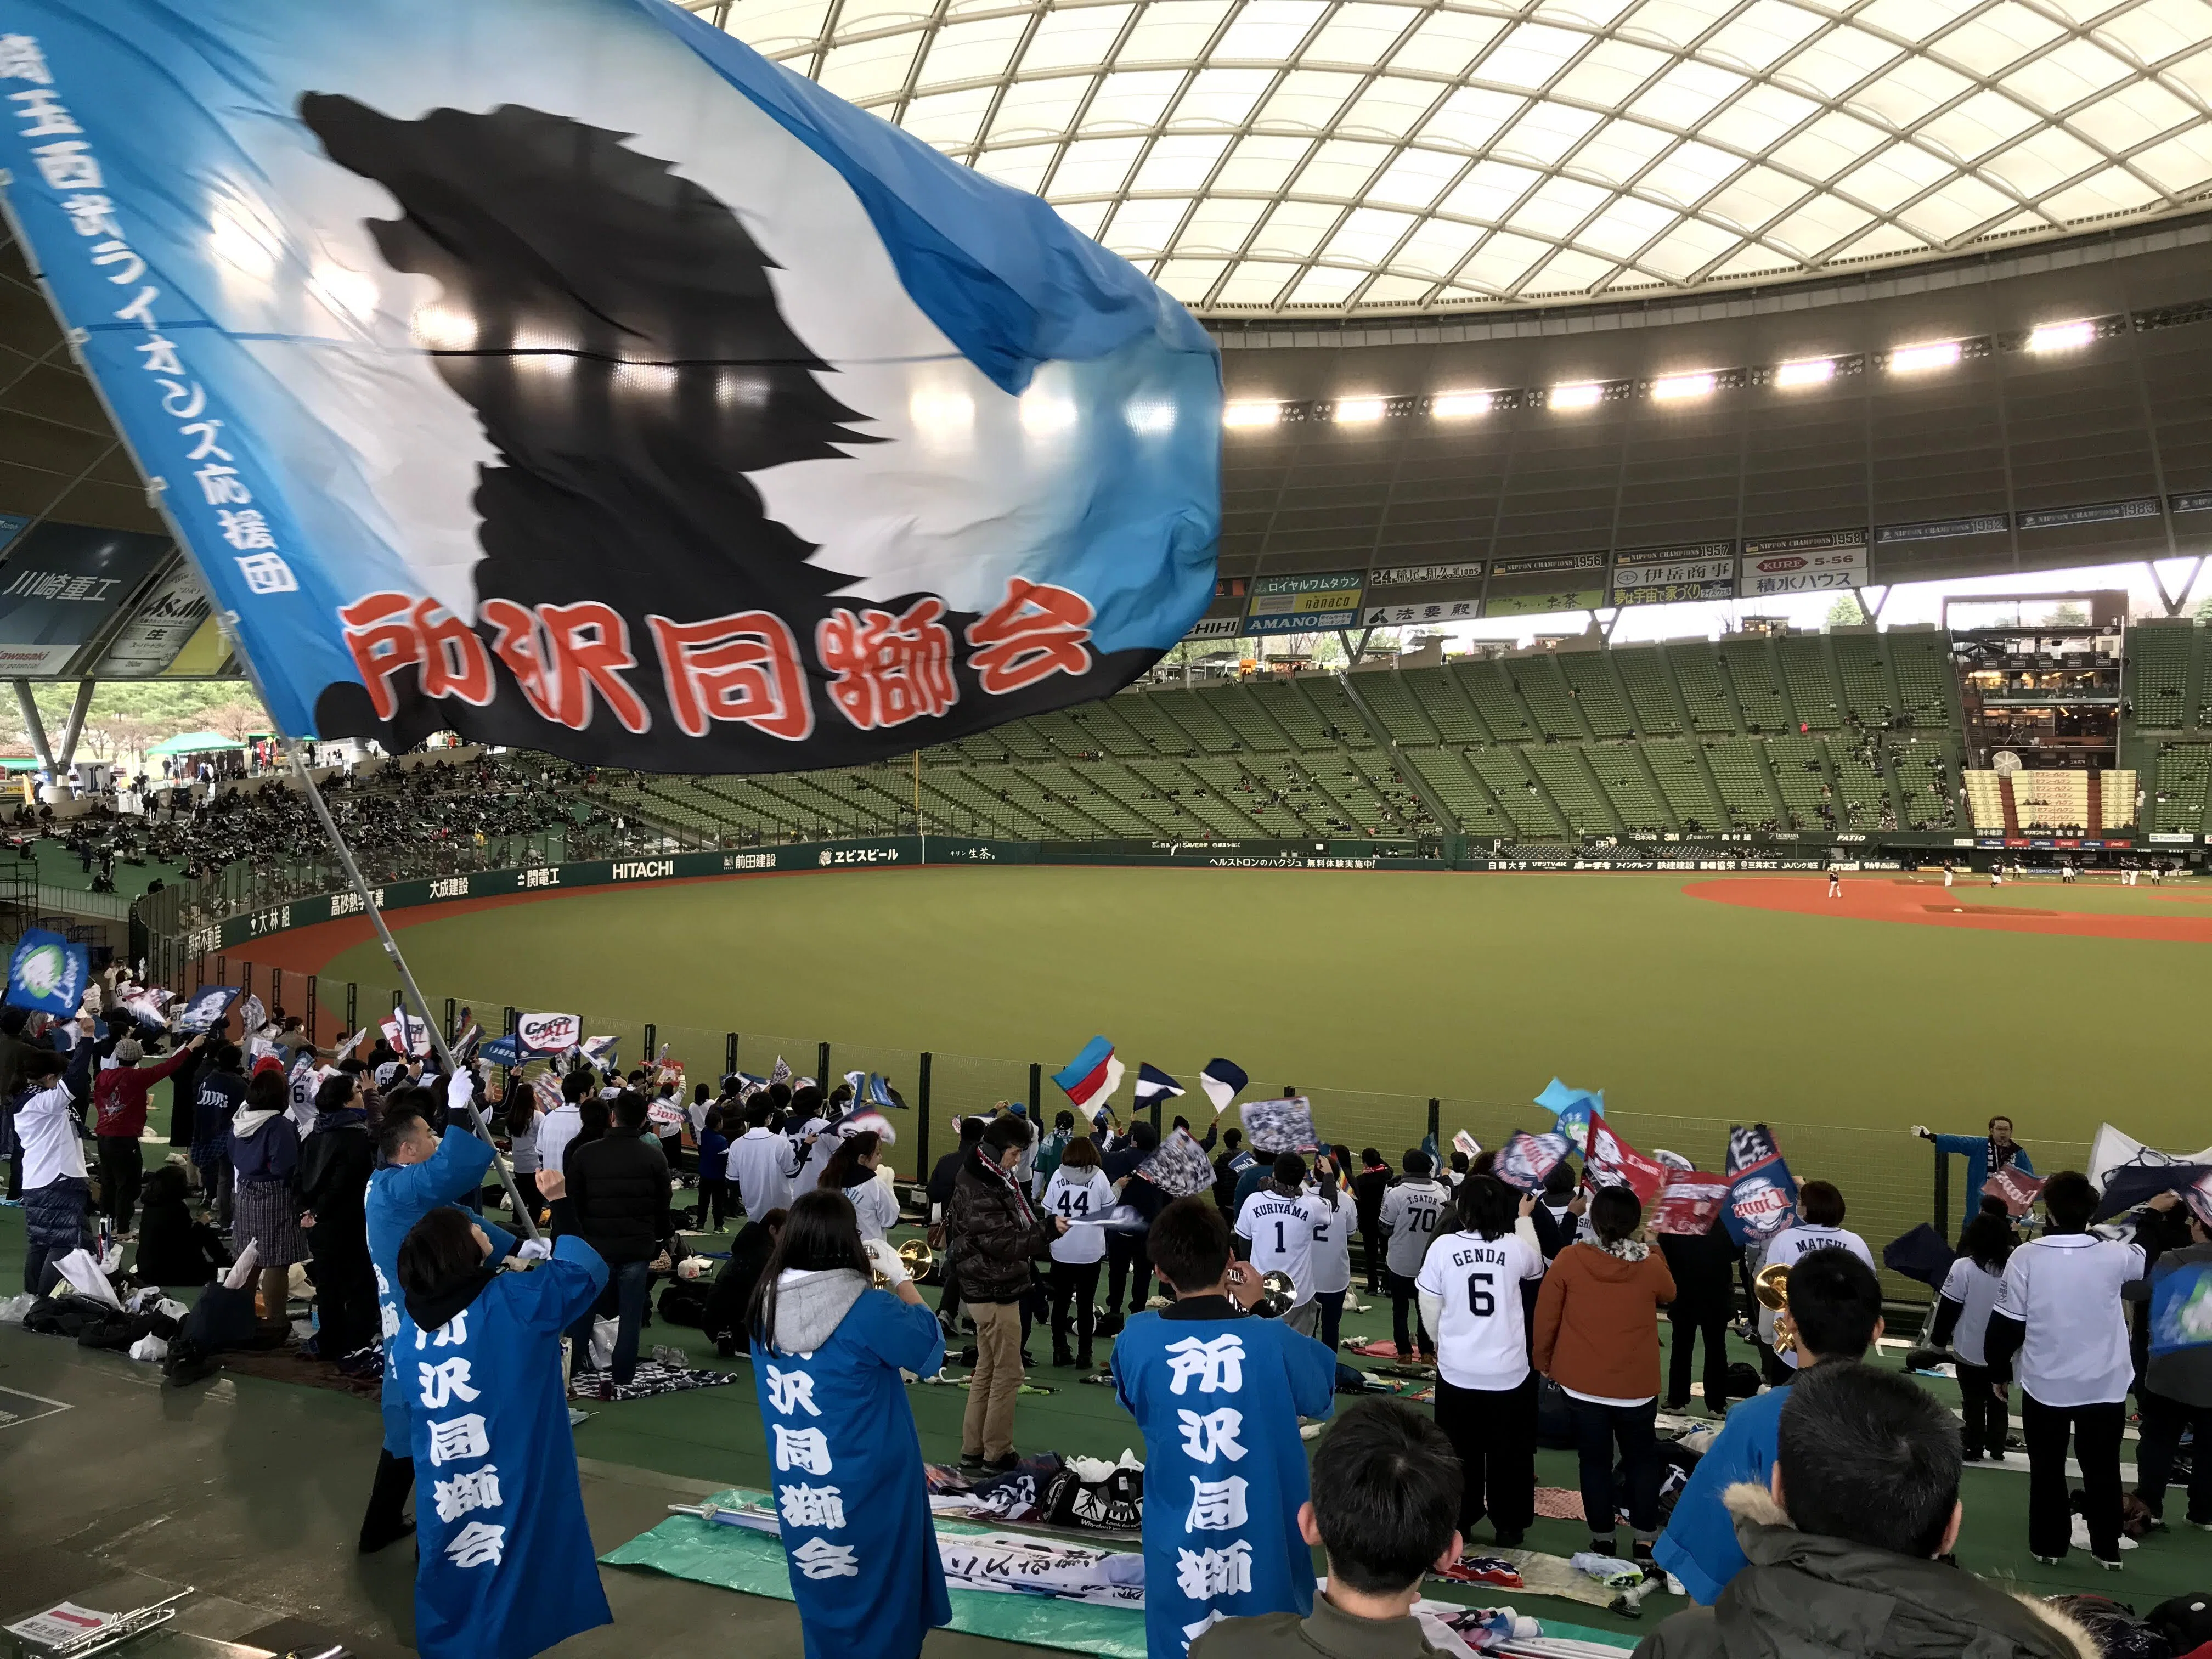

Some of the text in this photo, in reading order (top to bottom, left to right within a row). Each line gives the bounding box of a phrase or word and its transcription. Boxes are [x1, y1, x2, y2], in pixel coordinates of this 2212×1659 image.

[1971, 518, 2003, 533] 1982
[1789, 537, 1831, 547] CHAMPIONS
[1832, 531, 1863, 546] 1958
[1660, 549, 1700, 558] CHAMPIONS
[1701, 543, 1729, 557] 1957
[1534, 560, 1573, 568] CHAMPIONS
[1574, 555, 1602, 568] 1956
[1763, 555, 1854, 571] KURE 5-56
[1269, 577, 1360, 592] ロイヤルワムタウン
[1371, 569, 1392, 585] 24
[1453, 566, 1479, 577] Lions
[1757, 572, 1852, 592] 積水ハウス
[2, 570, 121, 602] 川崎重工
[1614, 583, 1701, 606] 夢は宇宙で家づくり
[1305, 596, 1351, 609] nanaco
[1396, 603, 1471, 620] 法要殿
[1249, 616, 1318, 630] AMANO
[145, 628, 168, 640] 生
[338, 574, 1096, 742] 所沢同獅会
[613, 860, 673, 879] HITACHI
[735, 853, 776, 869] 前田建設
[1210, 858, 1302, 867] ヘルストロンのハクジュ
[1573, 861, 1611, 870] ホーチキ
[1657, 861, 1695, 870] 鉄建建設
[1717, 860, 1736, 870] 協栄
[527, 868, 560, 888] 関電工
[429, 877, 469, 899] 大成建設
[259, 905, 291, 934] 大林組
[188, 924, 222, 960] 野村不動産
[293, 1085, 305, 1104] 6
[1057, 1190, 1089, 1217] 44
[1252, 1203, 1309, 1222] KURIYAMA
[1408, 1207, 1437, 1233] 70
[1274, 1221, 1286, 1253] 1
[1452, 1248, 1506, 1267] GENDA
[1468, 1273, 1495, 1317] 6
[764, 1350, 859, 1580] 沢同獅会
[1081, 1519, 1095, 1528] Why
